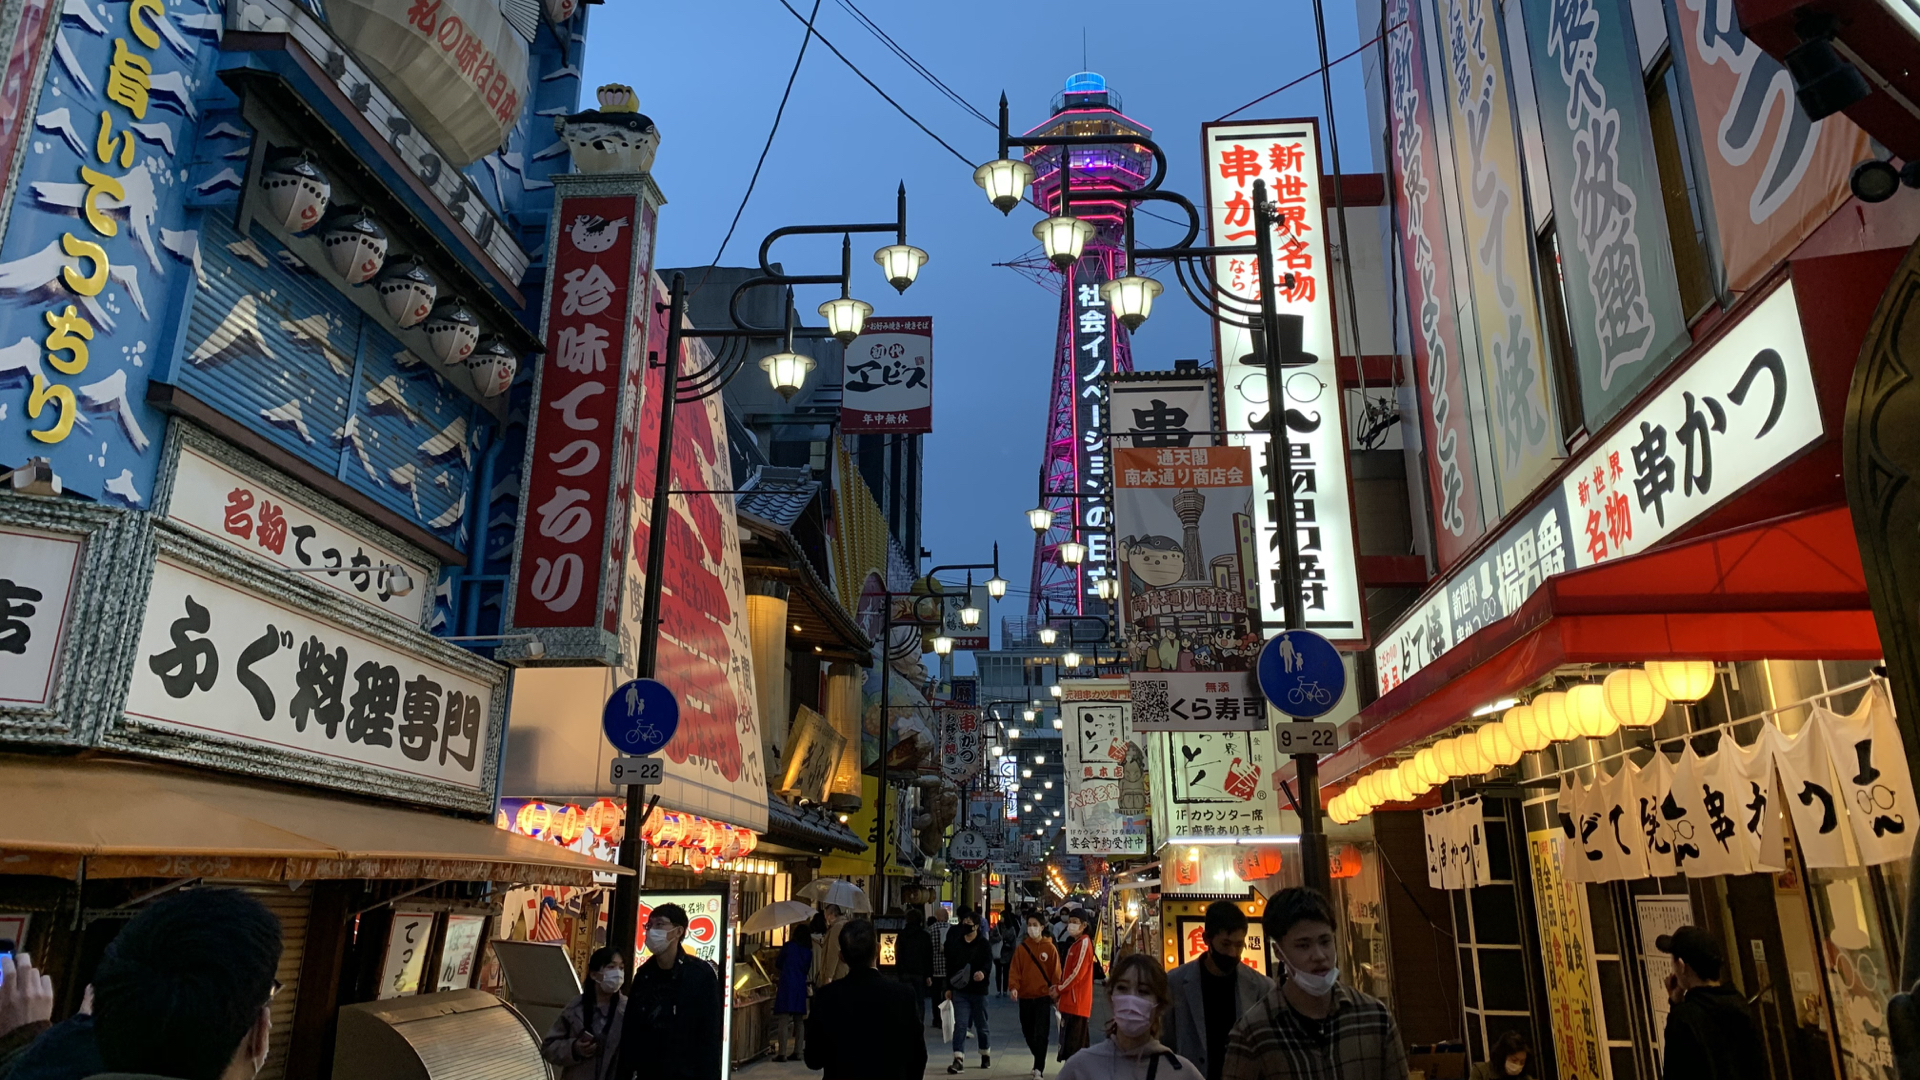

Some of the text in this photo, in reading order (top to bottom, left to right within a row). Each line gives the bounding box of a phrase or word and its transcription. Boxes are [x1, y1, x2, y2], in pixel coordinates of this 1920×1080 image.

[1268, 143, 1316, 303] 新世界名物
[1229, 259, 1246, 291] なら
[1467, 68, 1548, 475] どて焼
[870, 344, 905, 359] 初代
[863, 413, 909, 425] 年中無休
[529, 266, 616, 612] 珍味てっちり
[1631, 348, 1788, 528] 串かつ
[1156, 449, 1209, 466] 通天閣
[1124, 467, 1244, 487] 南本通り商店会
[1578, 450, 1623, 509] 新世界
[1585, 491, 1633, 564] 名物
[1133, 588, 1246, 613] 南本通り商店街
[1452, 575, 1478, 620] 新世界
[149, 594, 480, 773] ふぐ料理専門
[1204, 682, 1230, 693] 無添
[1169, 697, 1266, 721] くら寿司
[958, 711, 978, 765] 串かつ
[1175, 809, 1264, 822] 1F カウンター席
[1175, 825, 1188, 836] 2F
[1070, 836, 1144, 850] 宴会予約受付中
[392, 921, 419, 999] てっち
